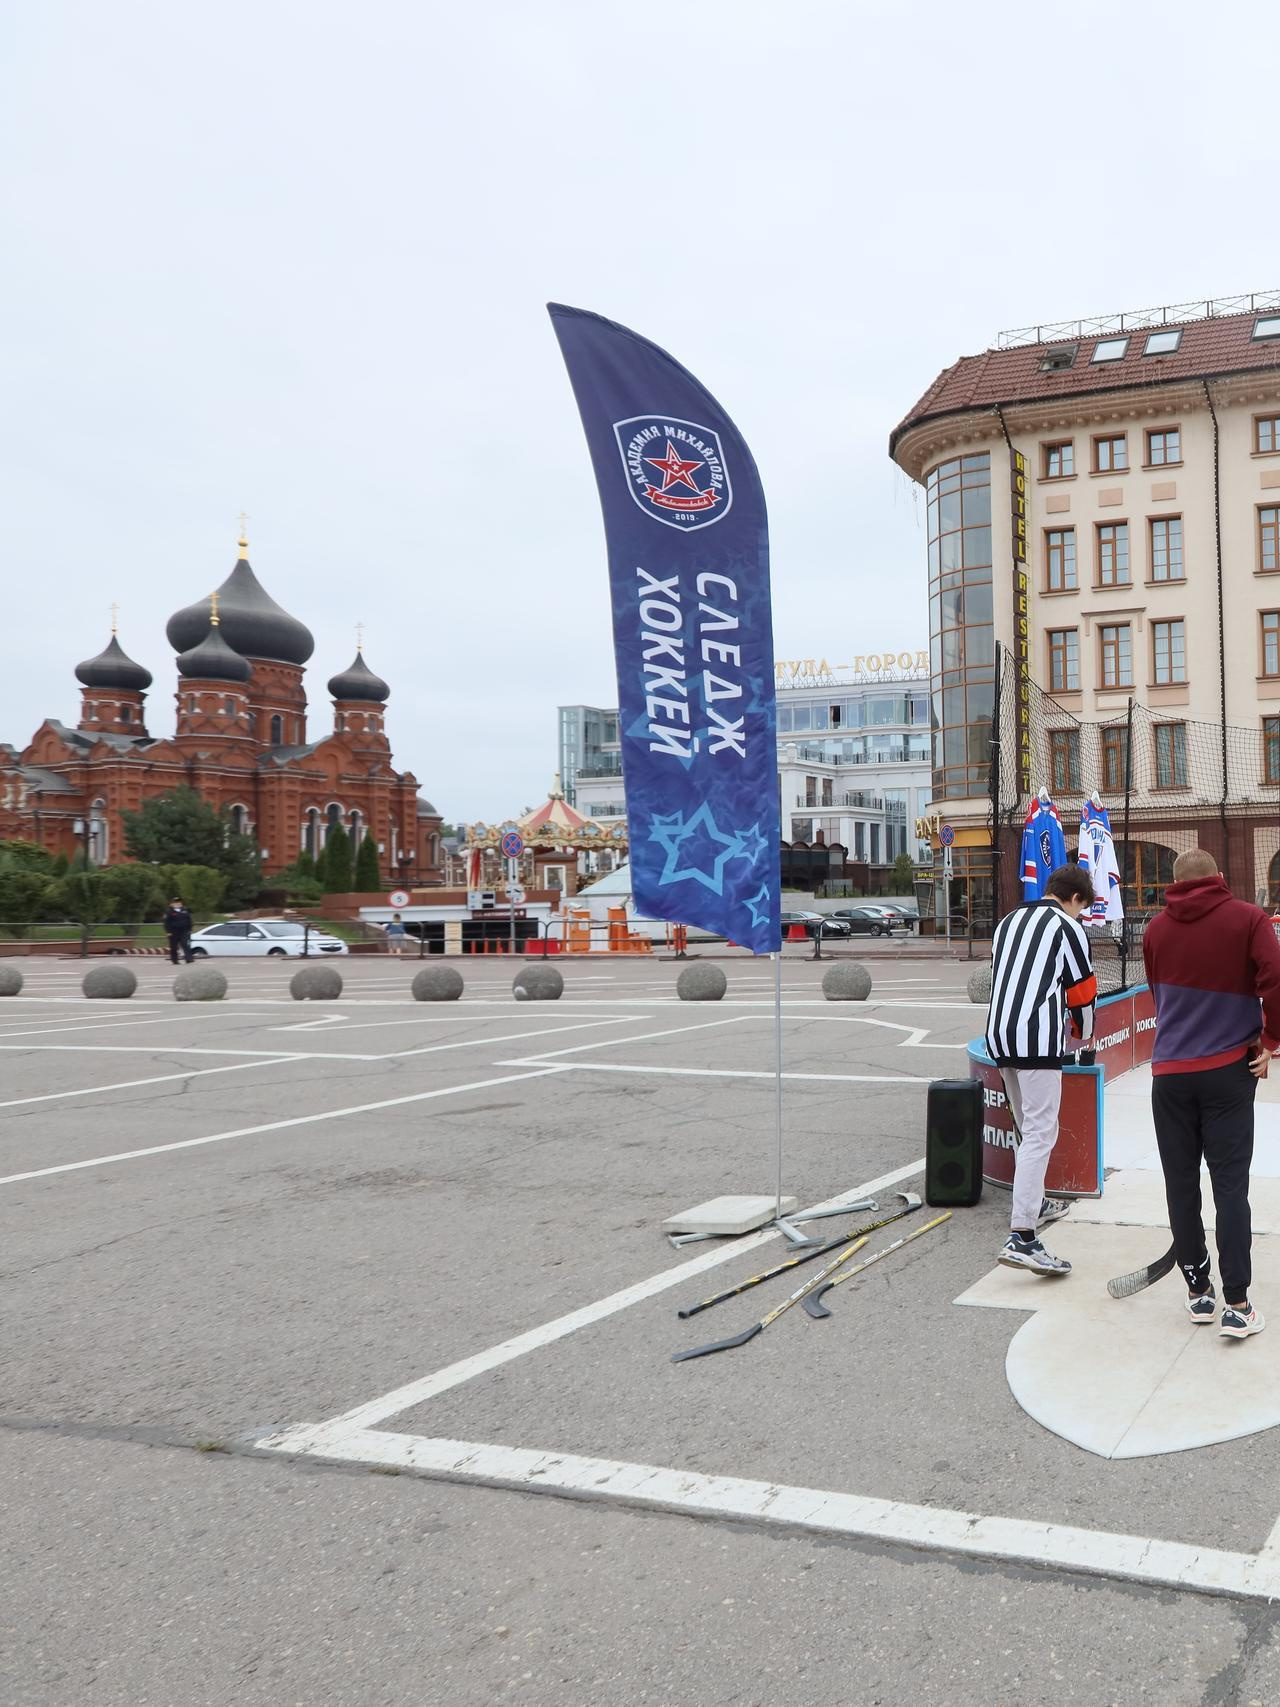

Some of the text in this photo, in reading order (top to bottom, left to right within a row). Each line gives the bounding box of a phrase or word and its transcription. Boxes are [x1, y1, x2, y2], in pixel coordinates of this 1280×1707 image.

[627, 425, 724, 490] АКАДЕМИЯ МИХАЙЛОВА
[1015, 452, 1026, 561] HOTEL
[636, 566, 700, 759] ХОККЕЙ
[696, 572, 746, 759] СЛЕДЖ
[775, 658, 832, 679] ТУЛА
[1095, 1027, 1130, 1052] АСТОЯЩИХ
